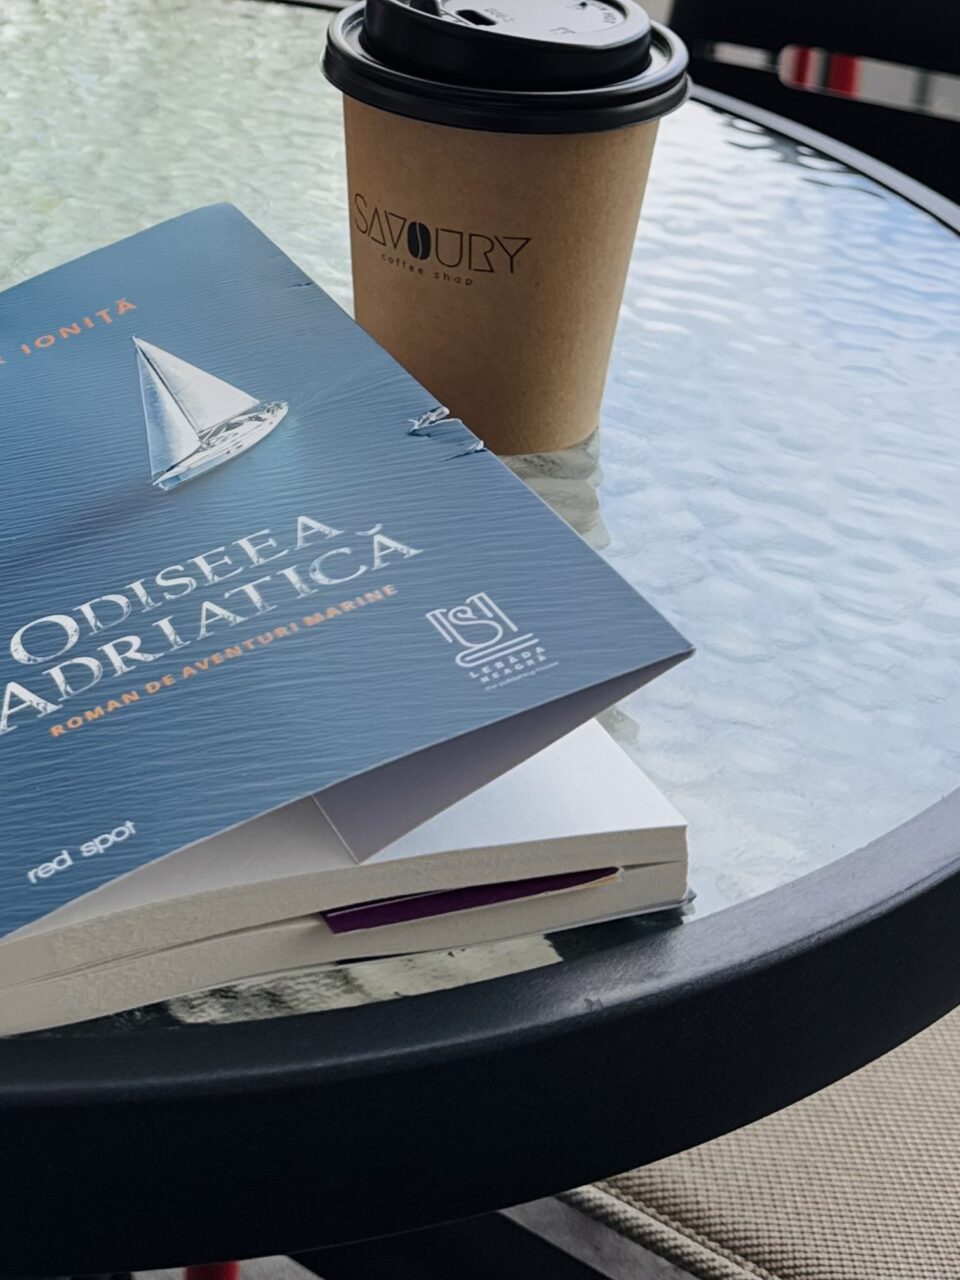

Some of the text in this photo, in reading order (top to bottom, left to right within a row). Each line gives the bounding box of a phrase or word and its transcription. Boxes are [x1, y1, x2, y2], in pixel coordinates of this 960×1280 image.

[354, 193, 531, 274] SAVOURY
[381, 253, 473, 286] coffee shop
[9, 515, 345, 665] ODISEEA
[49, 584, 399, 737] ROMAN DE AVENTURI MARINE
[27, 820, 136, 884] red spot
